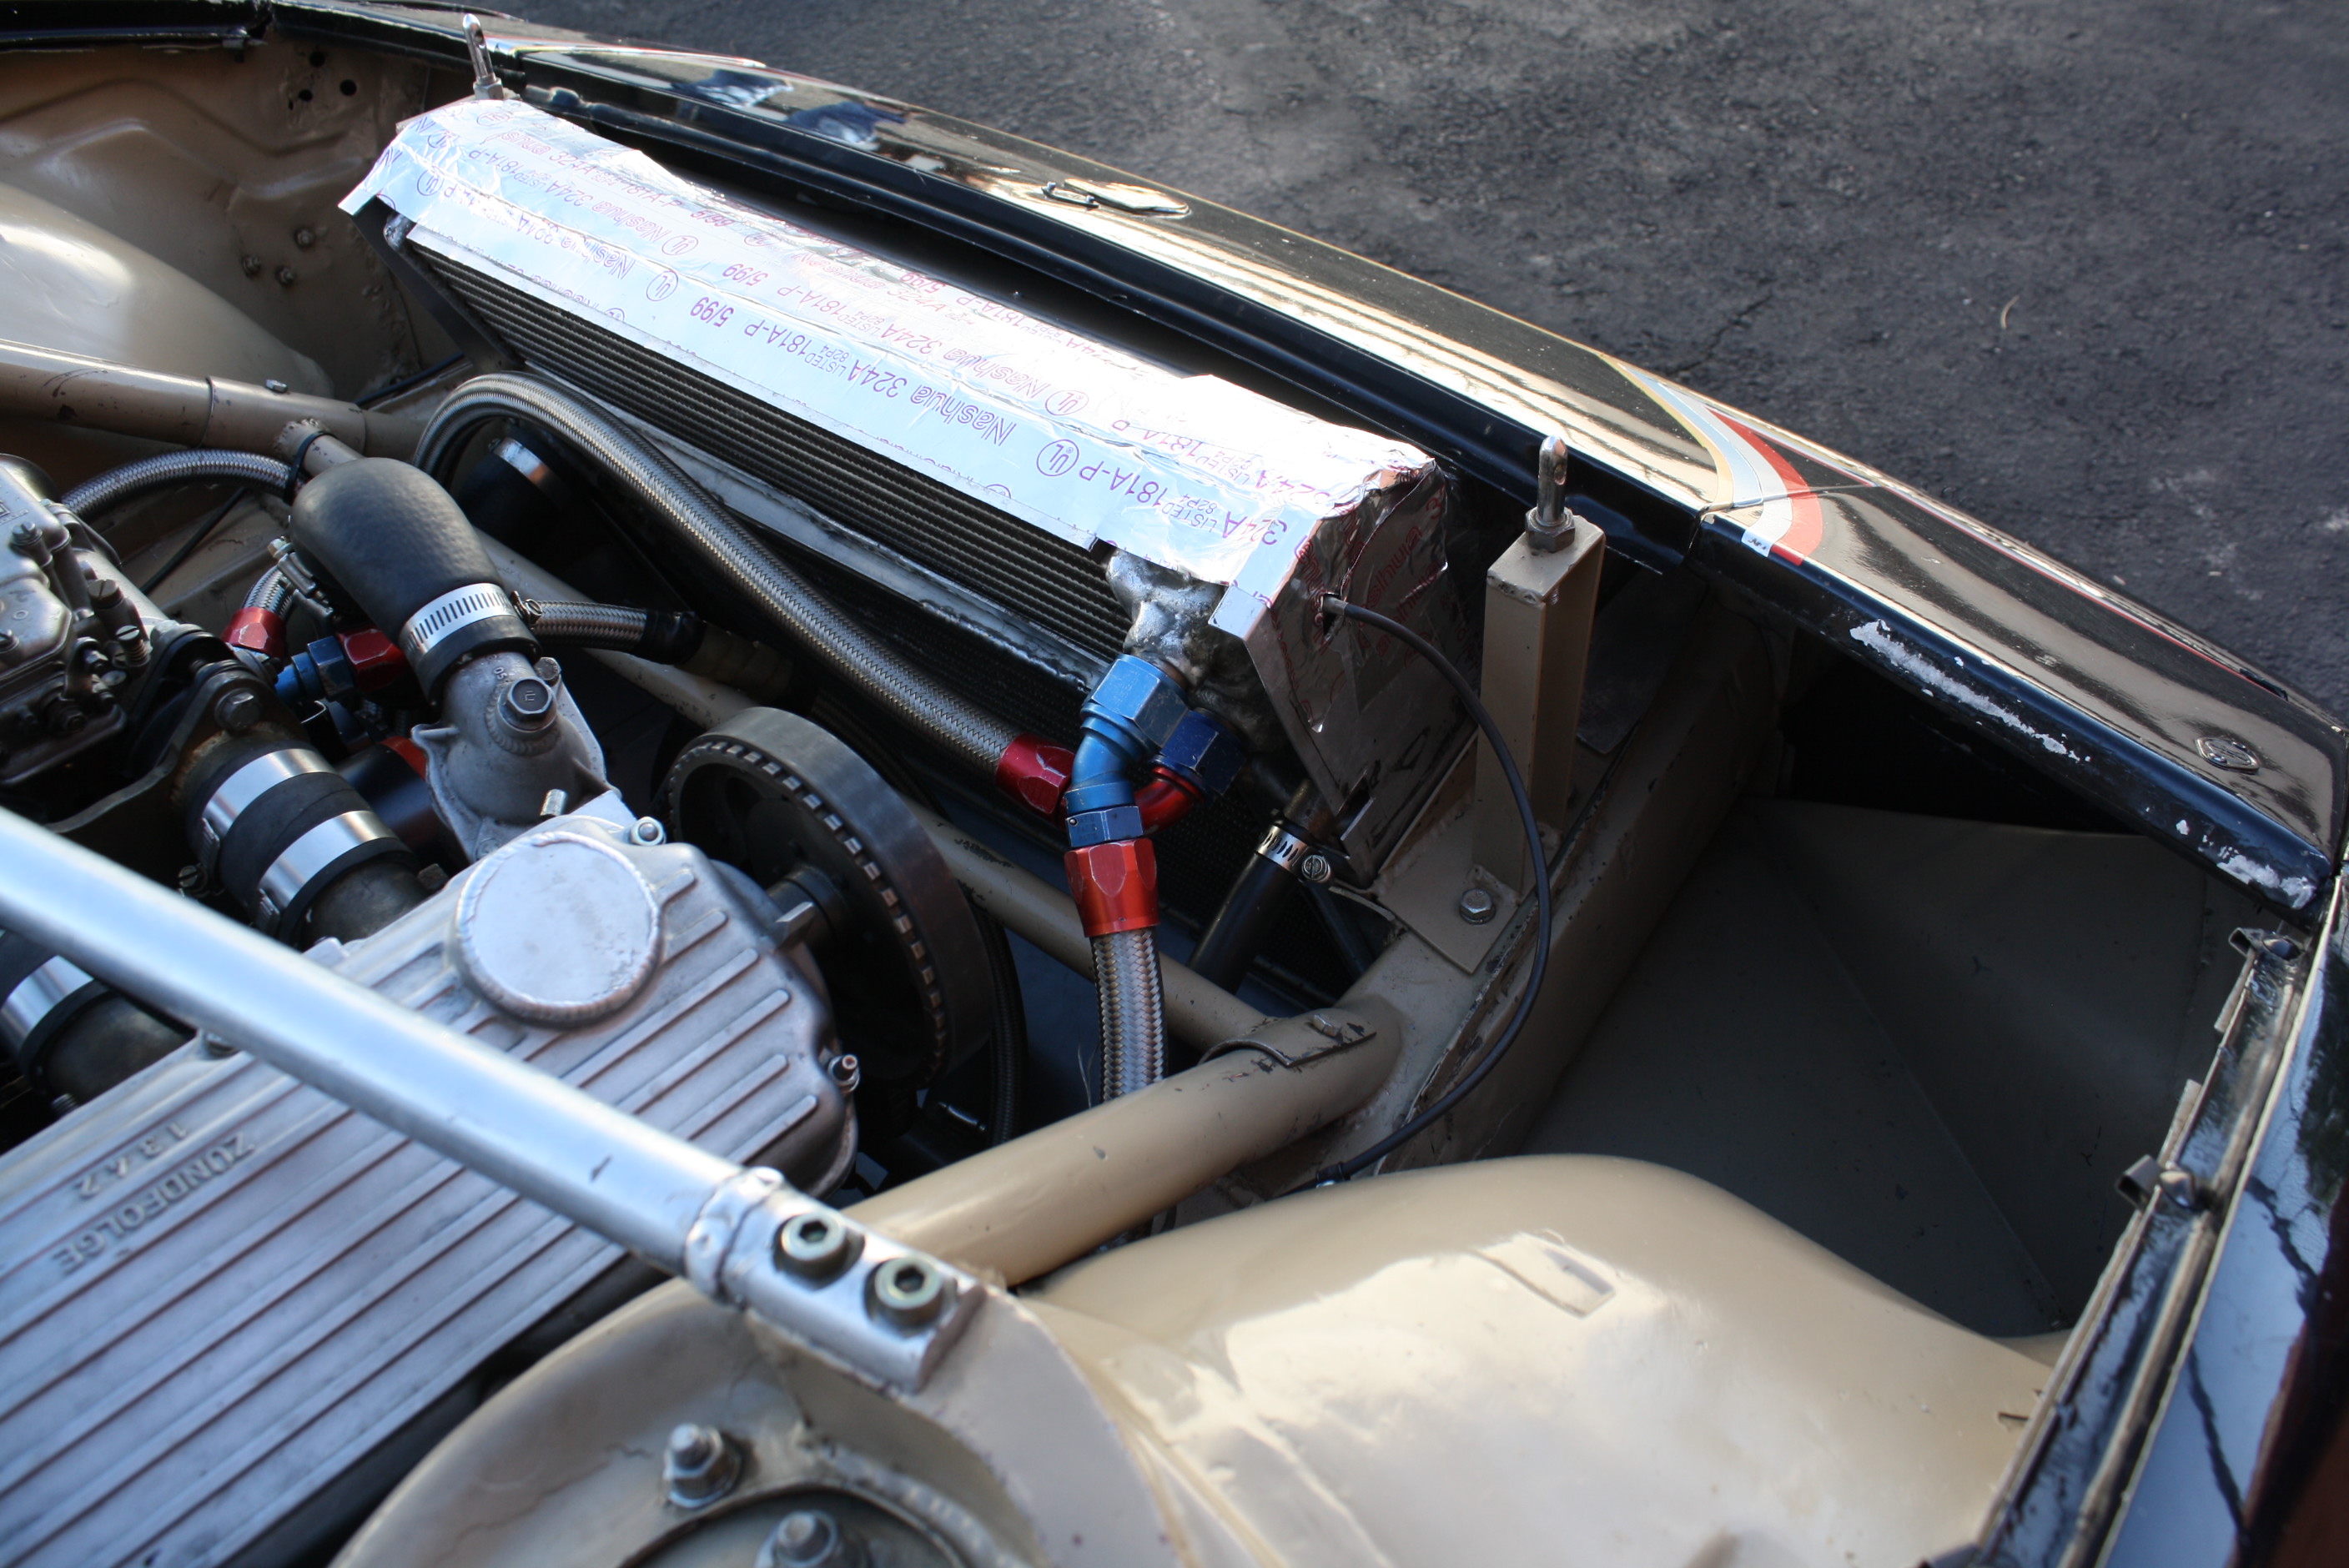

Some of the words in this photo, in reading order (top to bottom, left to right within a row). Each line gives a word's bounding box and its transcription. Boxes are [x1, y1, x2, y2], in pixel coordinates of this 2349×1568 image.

[468, 148, 525, 179] 181A-P
[545, 180, 594, 207] 324A
[591, 200, 672, 244] Nashua
[560, 234, 636, 280] Nashua
[722, 264, 769, 287] 5/99
[689, 296, 735, 329] 5/99
[777, 285, 848, 316] 181A-P
[837, 314, 881, 334] LISTED
[858, 310, 886, 326] 82P4
[743, 319, 813, 356] 181A-P
[819, 343, 850, 363] 82P4
[881, 323, 943, 354] 324A
[803, 351, 848, 377] LISTED
[847, 359, 908, 399] 324A
[943, 348, 1051, 399] Nashua
[909, 384, 1018, 447] Nashua
[1078, 460, 1169, 507] 181A-P
[1161, 502, 1218, 533] LISTED
[1179, 493, 1219, 515] 82P4
